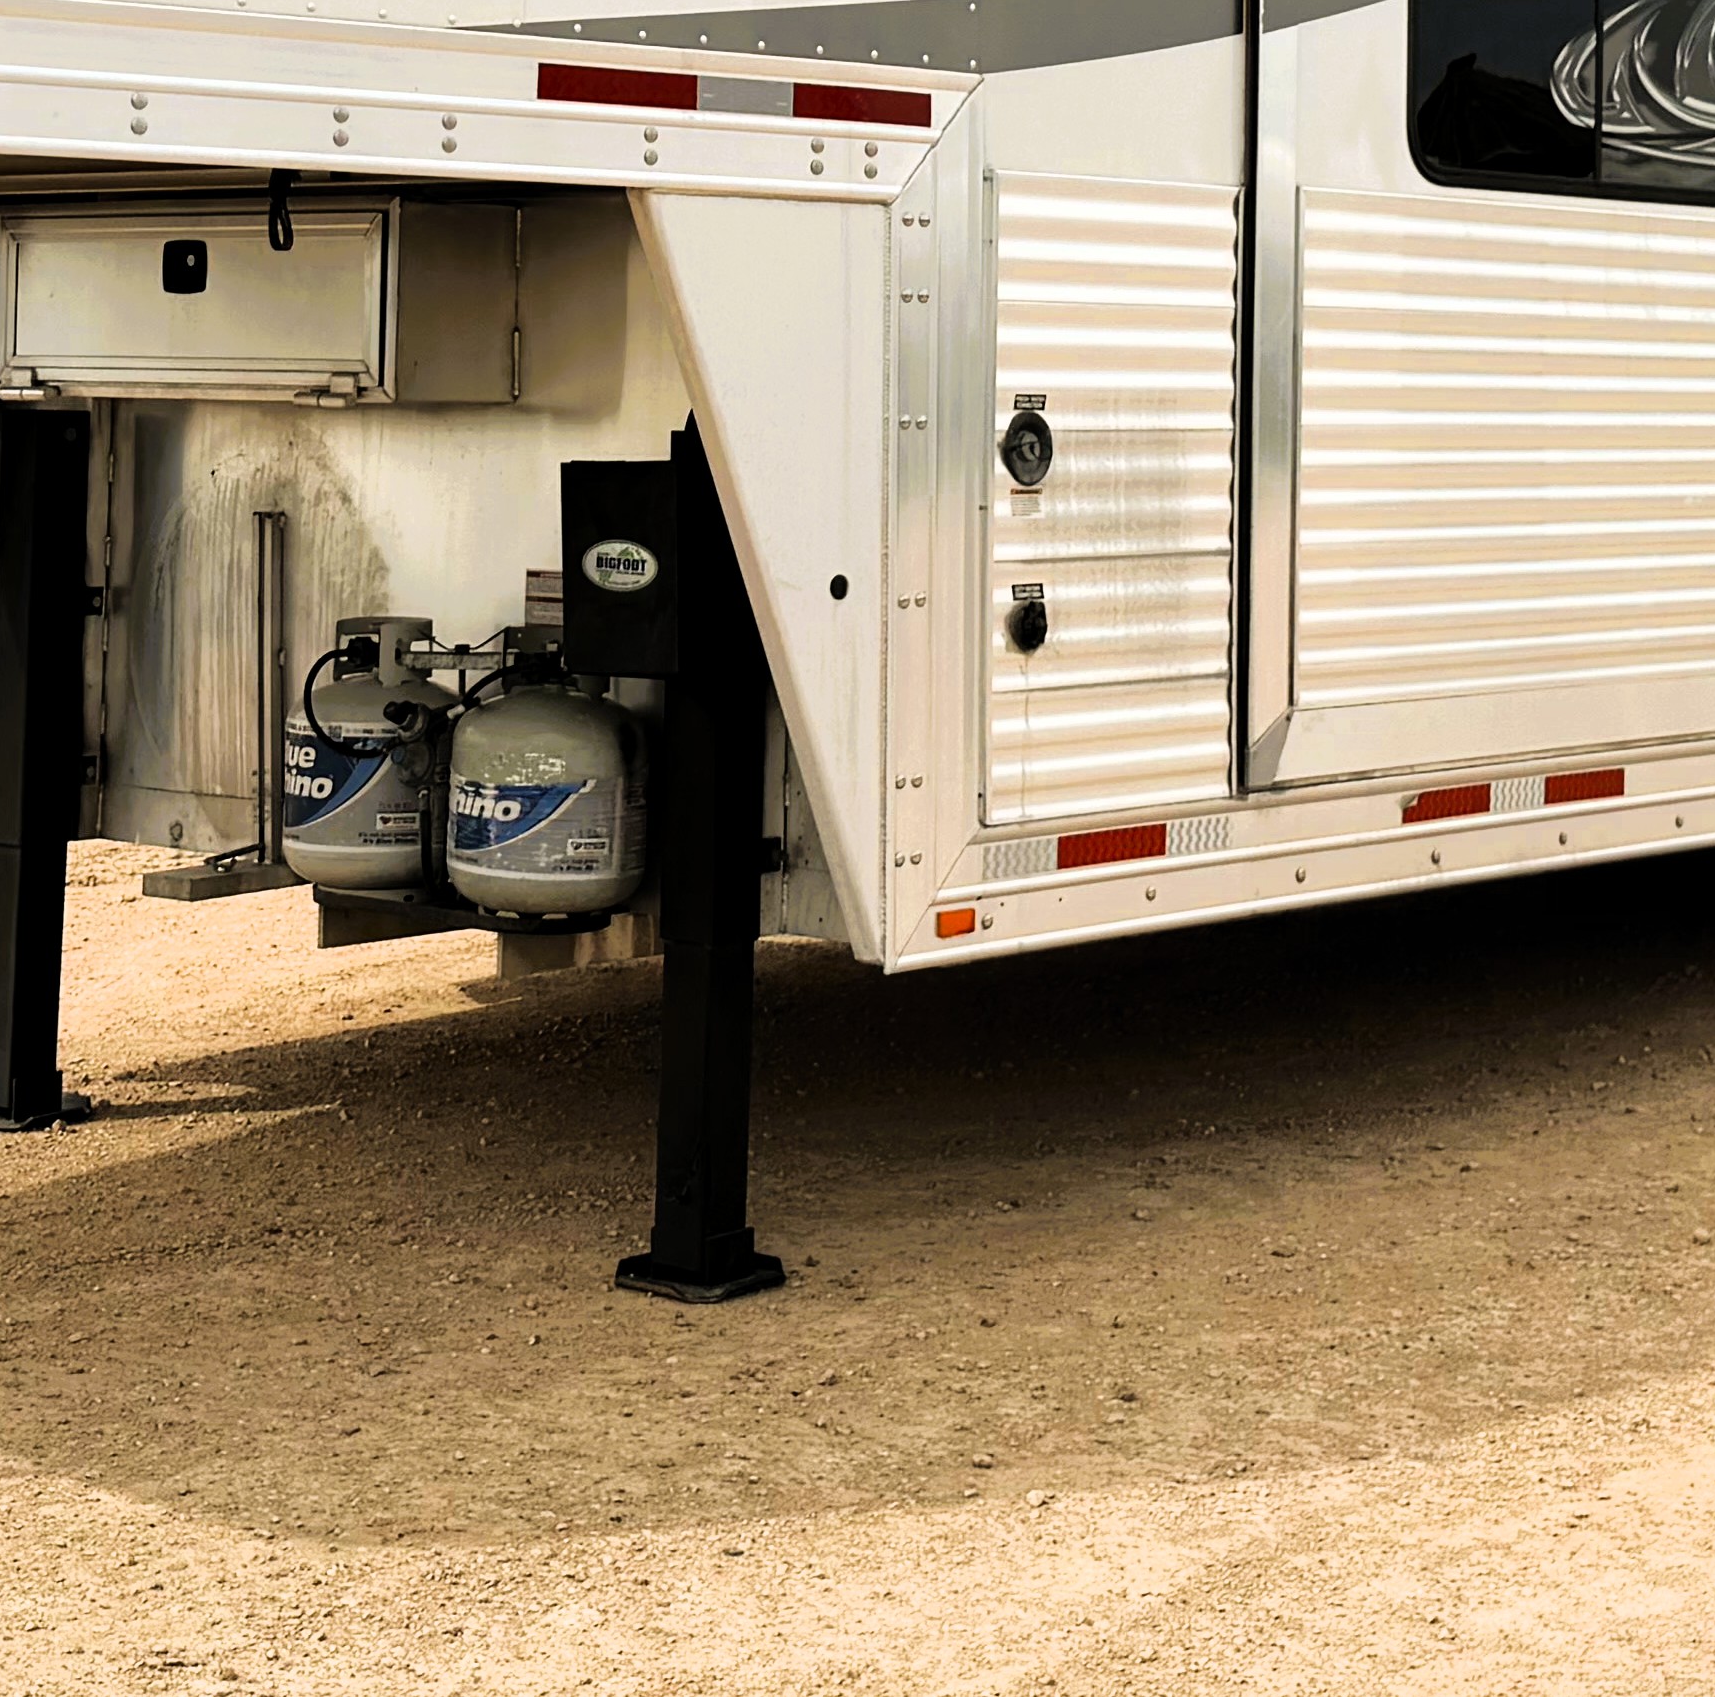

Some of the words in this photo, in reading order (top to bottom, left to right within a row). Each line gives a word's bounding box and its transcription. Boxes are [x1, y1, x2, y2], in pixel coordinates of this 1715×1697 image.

[596, 556, 647, 572] BIGFOOT
[285, 739, 316, 769] lue
[284, 766, 334, 800] hino
[450, 786, 522, 822] hino
